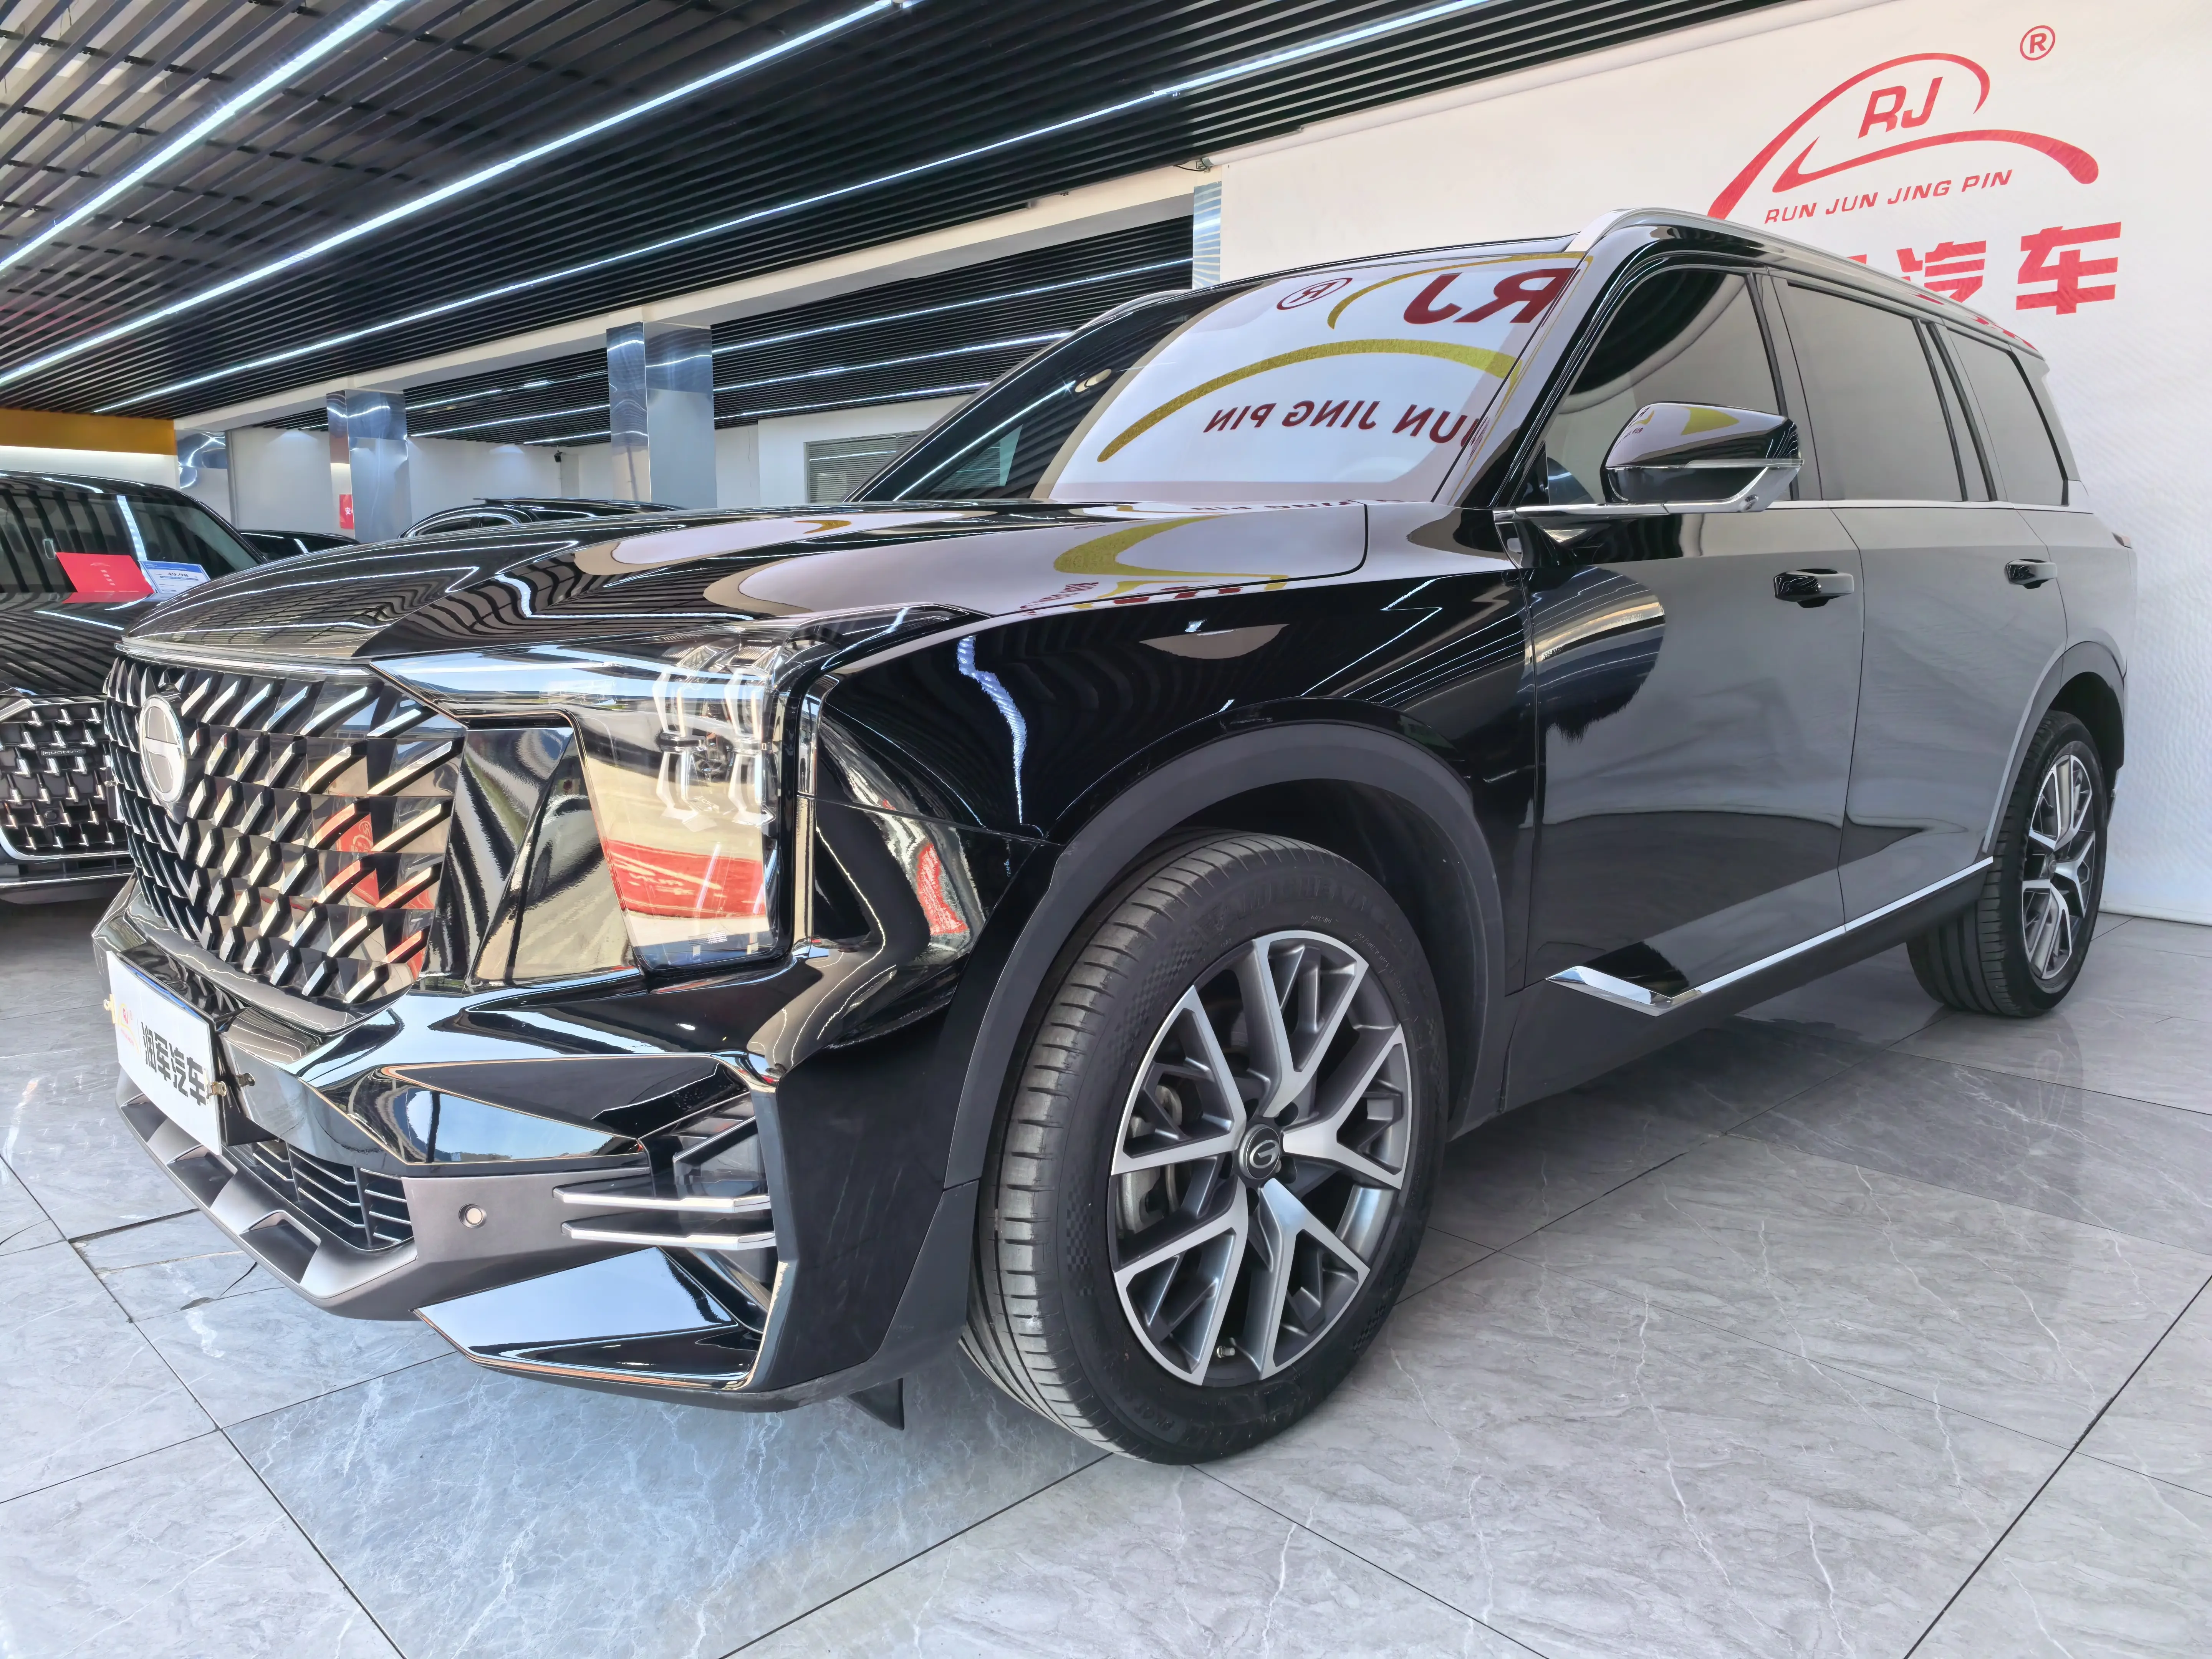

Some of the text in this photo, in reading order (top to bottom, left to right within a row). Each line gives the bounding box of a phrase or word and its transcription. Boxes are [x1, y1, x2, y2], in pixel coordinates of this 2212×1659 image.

[1858, 76, 1943, 139] RJ
[1764, 169, 2012, 224] RUN JUN JING PIN
[1849, 222, 2121, 315] 汽车
[141, 1022, 207, 1106] 润军汽车
